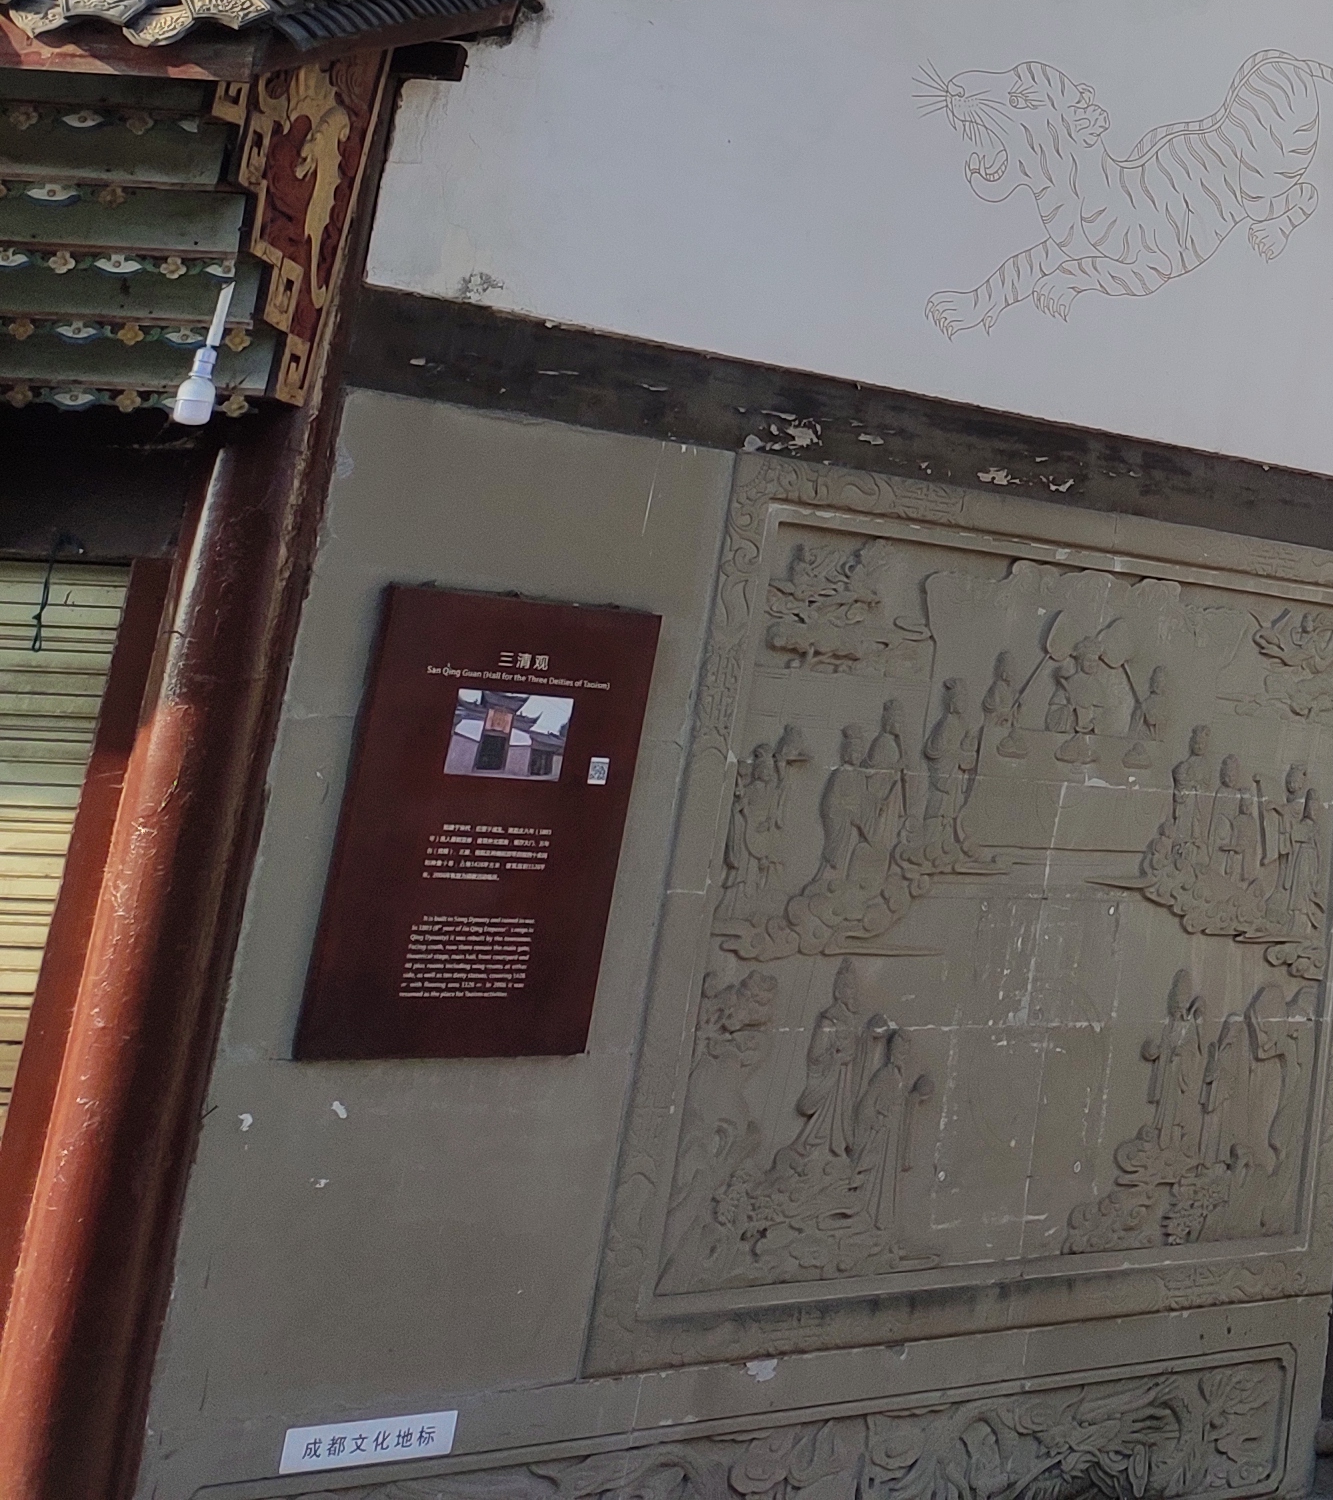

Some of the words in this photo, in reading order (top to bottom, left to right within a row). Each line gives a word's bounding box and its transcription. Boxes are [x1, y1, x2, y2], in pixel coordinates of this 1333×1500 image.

[498, 652, 549, 671] 三清观
[427, 665, 441, 674] San
[462, 668, 482, 678] Guan
[501, 672, 513, 681] for
[514, 673, 527, 682] the
[527, 674, 548, 684] Three
[549, 676, 574, 687] Deities
[574, 679, 582, 687] of
[301, 1425, 436, 1460] 成都文化地标
